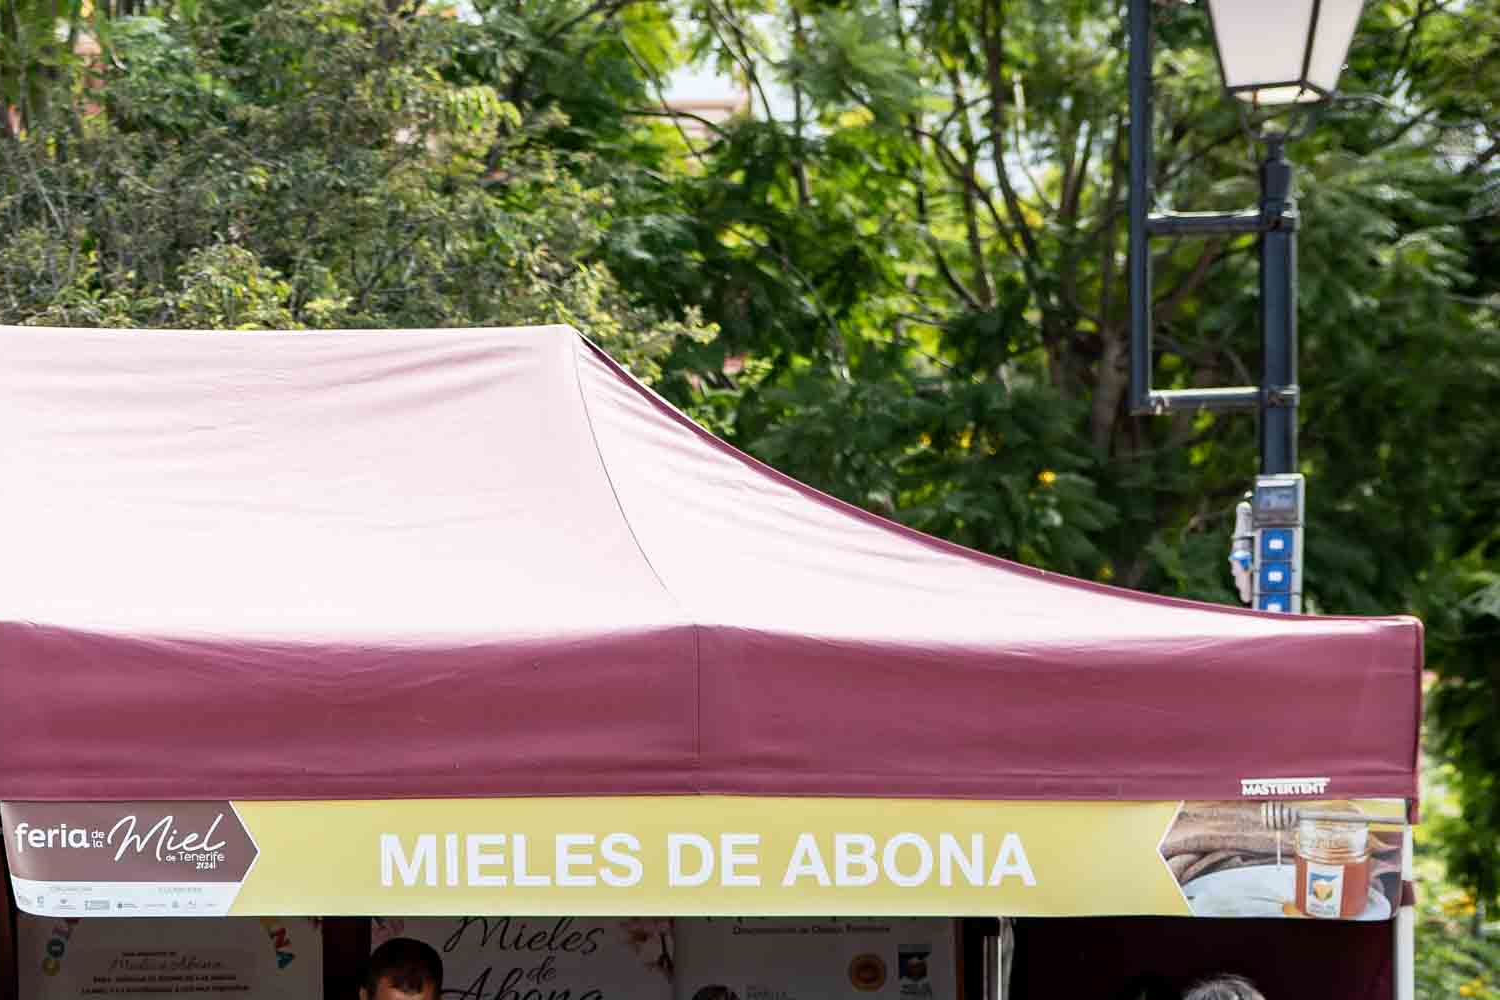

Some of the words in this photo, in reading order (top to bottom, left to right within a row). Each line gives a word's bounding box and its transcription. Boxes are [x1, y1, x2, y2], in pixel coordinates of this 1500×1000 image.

[14, 823, 91, 852] feria
[91, 830, 105, 839] de
[92, 839, 104, 848] la
[107, 813, 226, 862] Miel
[177, 850, 225, 866] Tenerife
[379, 832, 645, 887] MIELES
[666, 832, 761, 887] DE
[781, 832, 1038, 887] ABONA
[443, 916, 605, 952] Mieles
[526, 956, 556, 984] de
